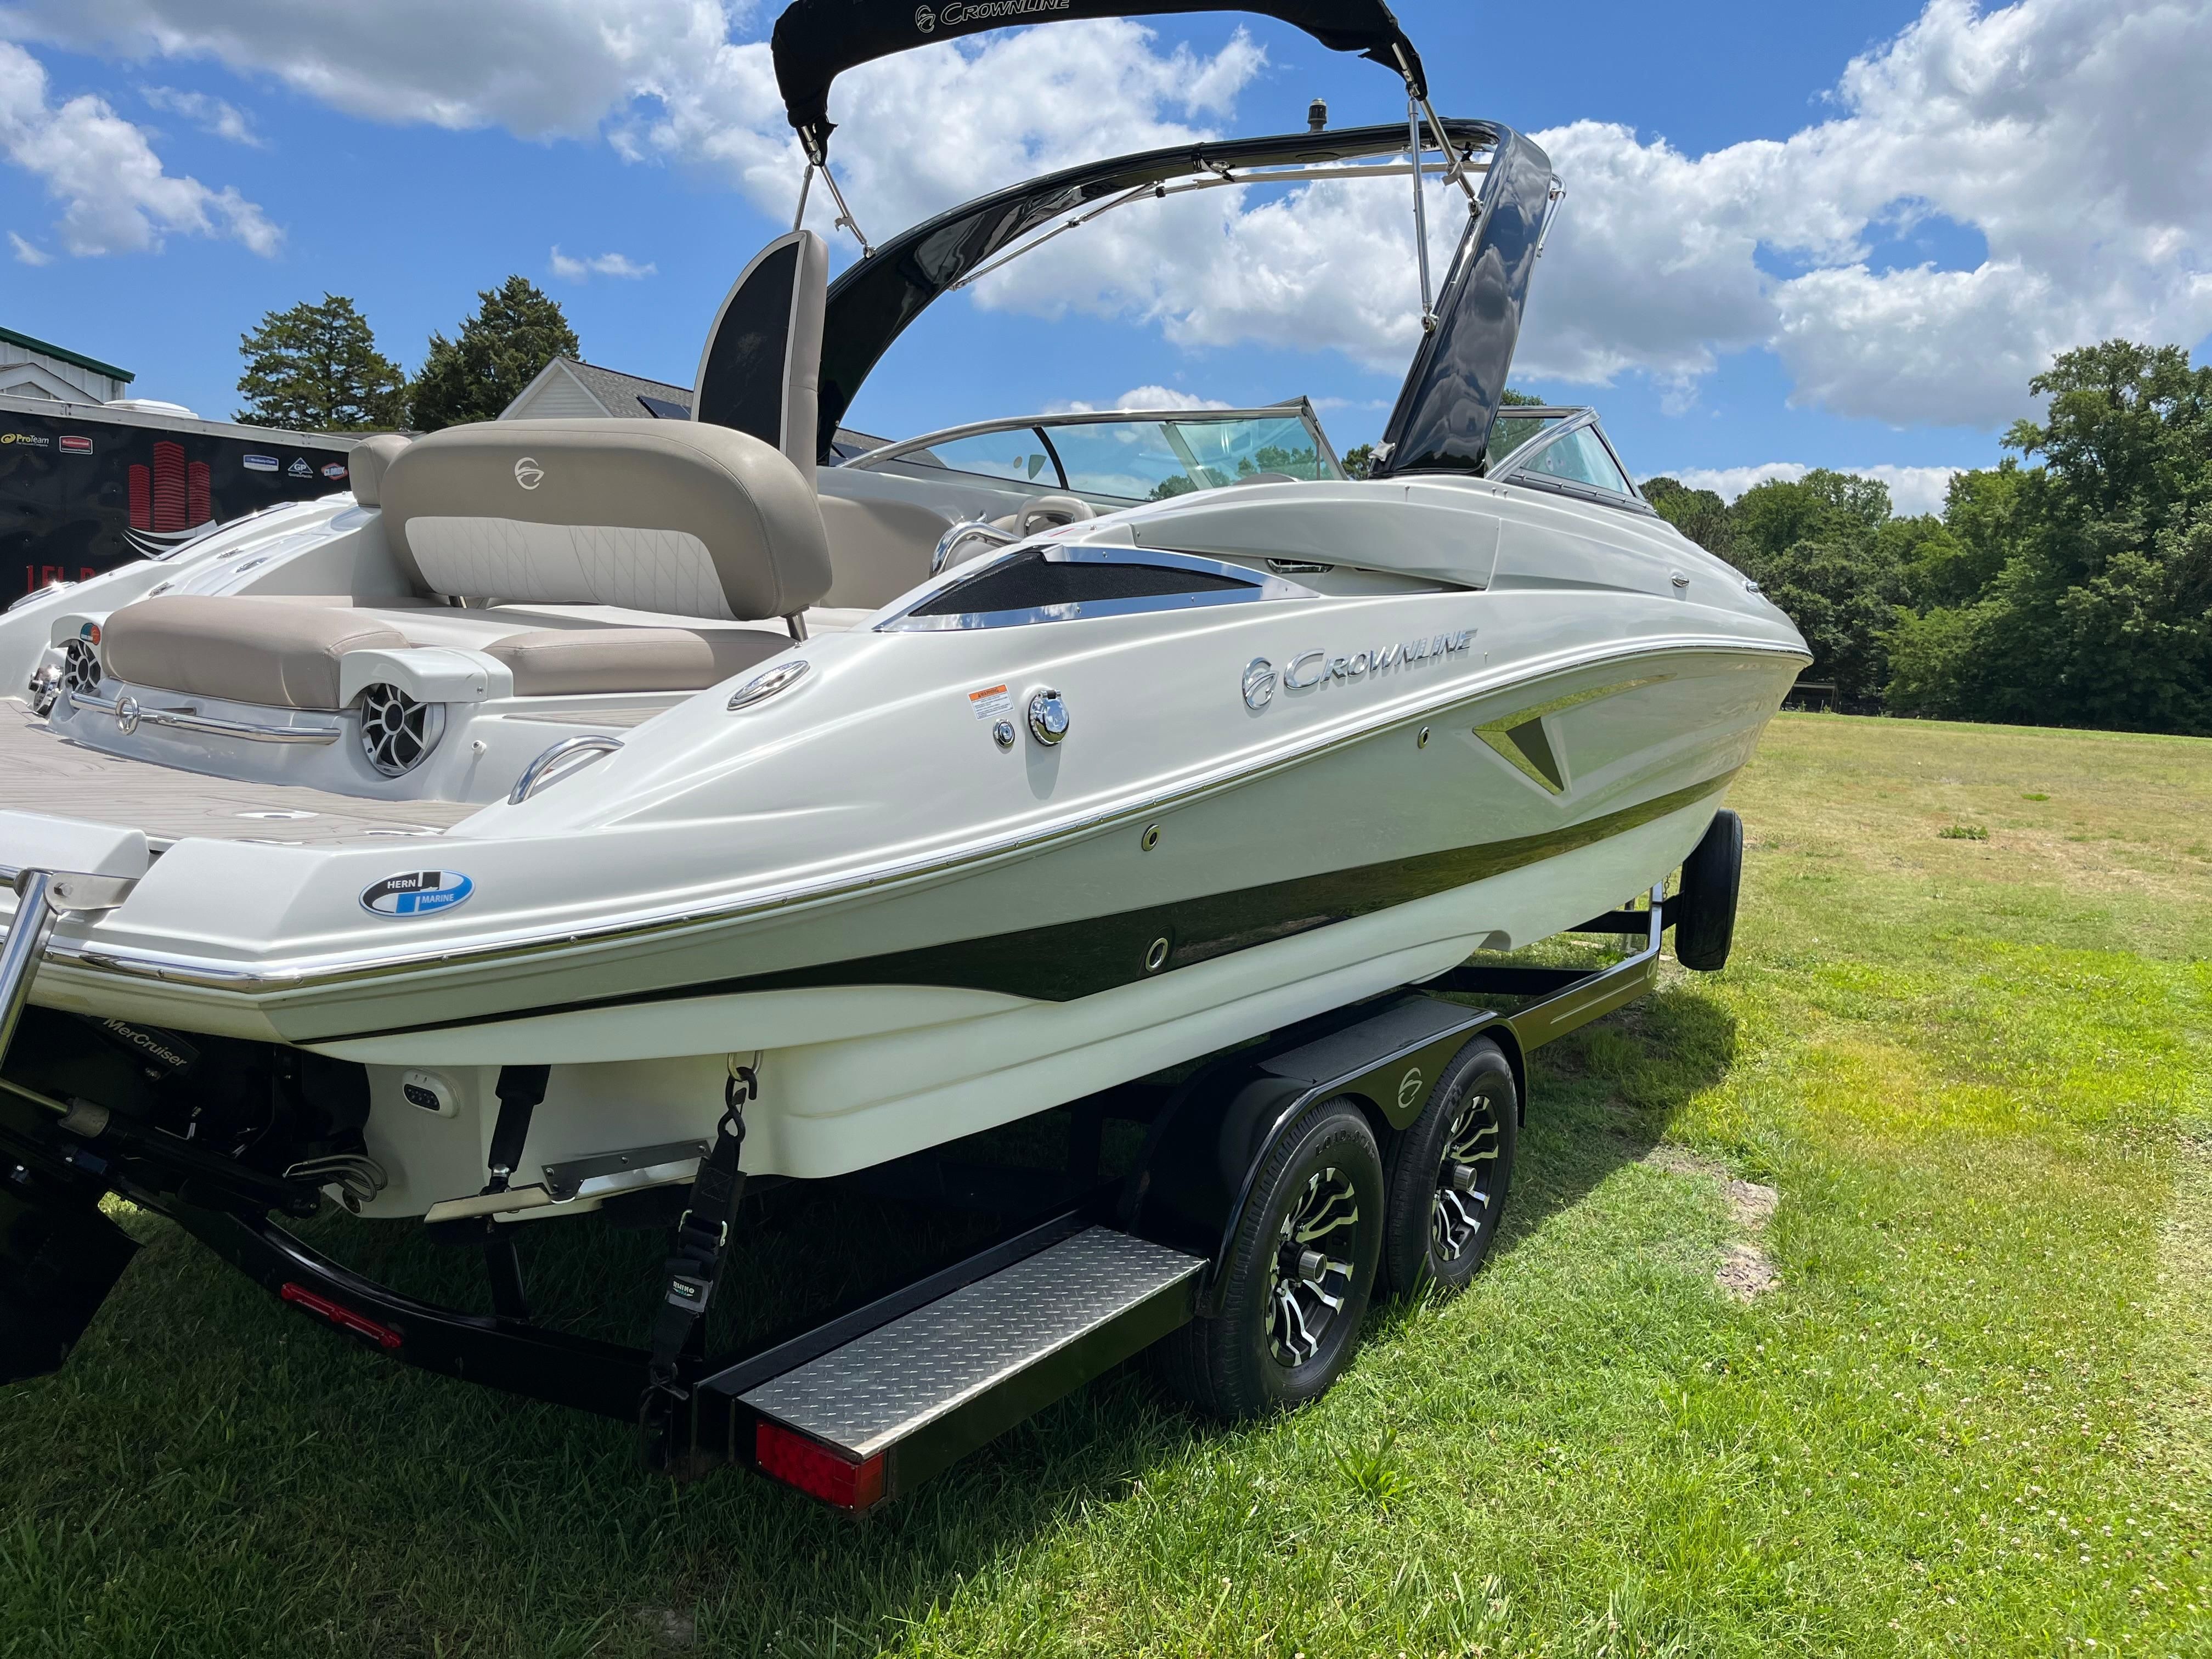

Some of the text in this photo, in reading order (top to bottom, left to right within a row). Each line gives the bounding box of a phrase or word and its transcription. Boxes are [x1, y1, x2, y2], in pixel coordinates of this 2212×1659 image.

[16, 433, 49, 444] ProTeam
[324, 466, 345, 477] CLOROX
[1283, 628, 1479, 690] CROWNLINE
[387, 879, 416, 889] HERN
[422, 894, 454, 904] MARINE
[103, 1019, 188, 1066] MerCruiser
[673, 1280, 695, 1294] RHINO
